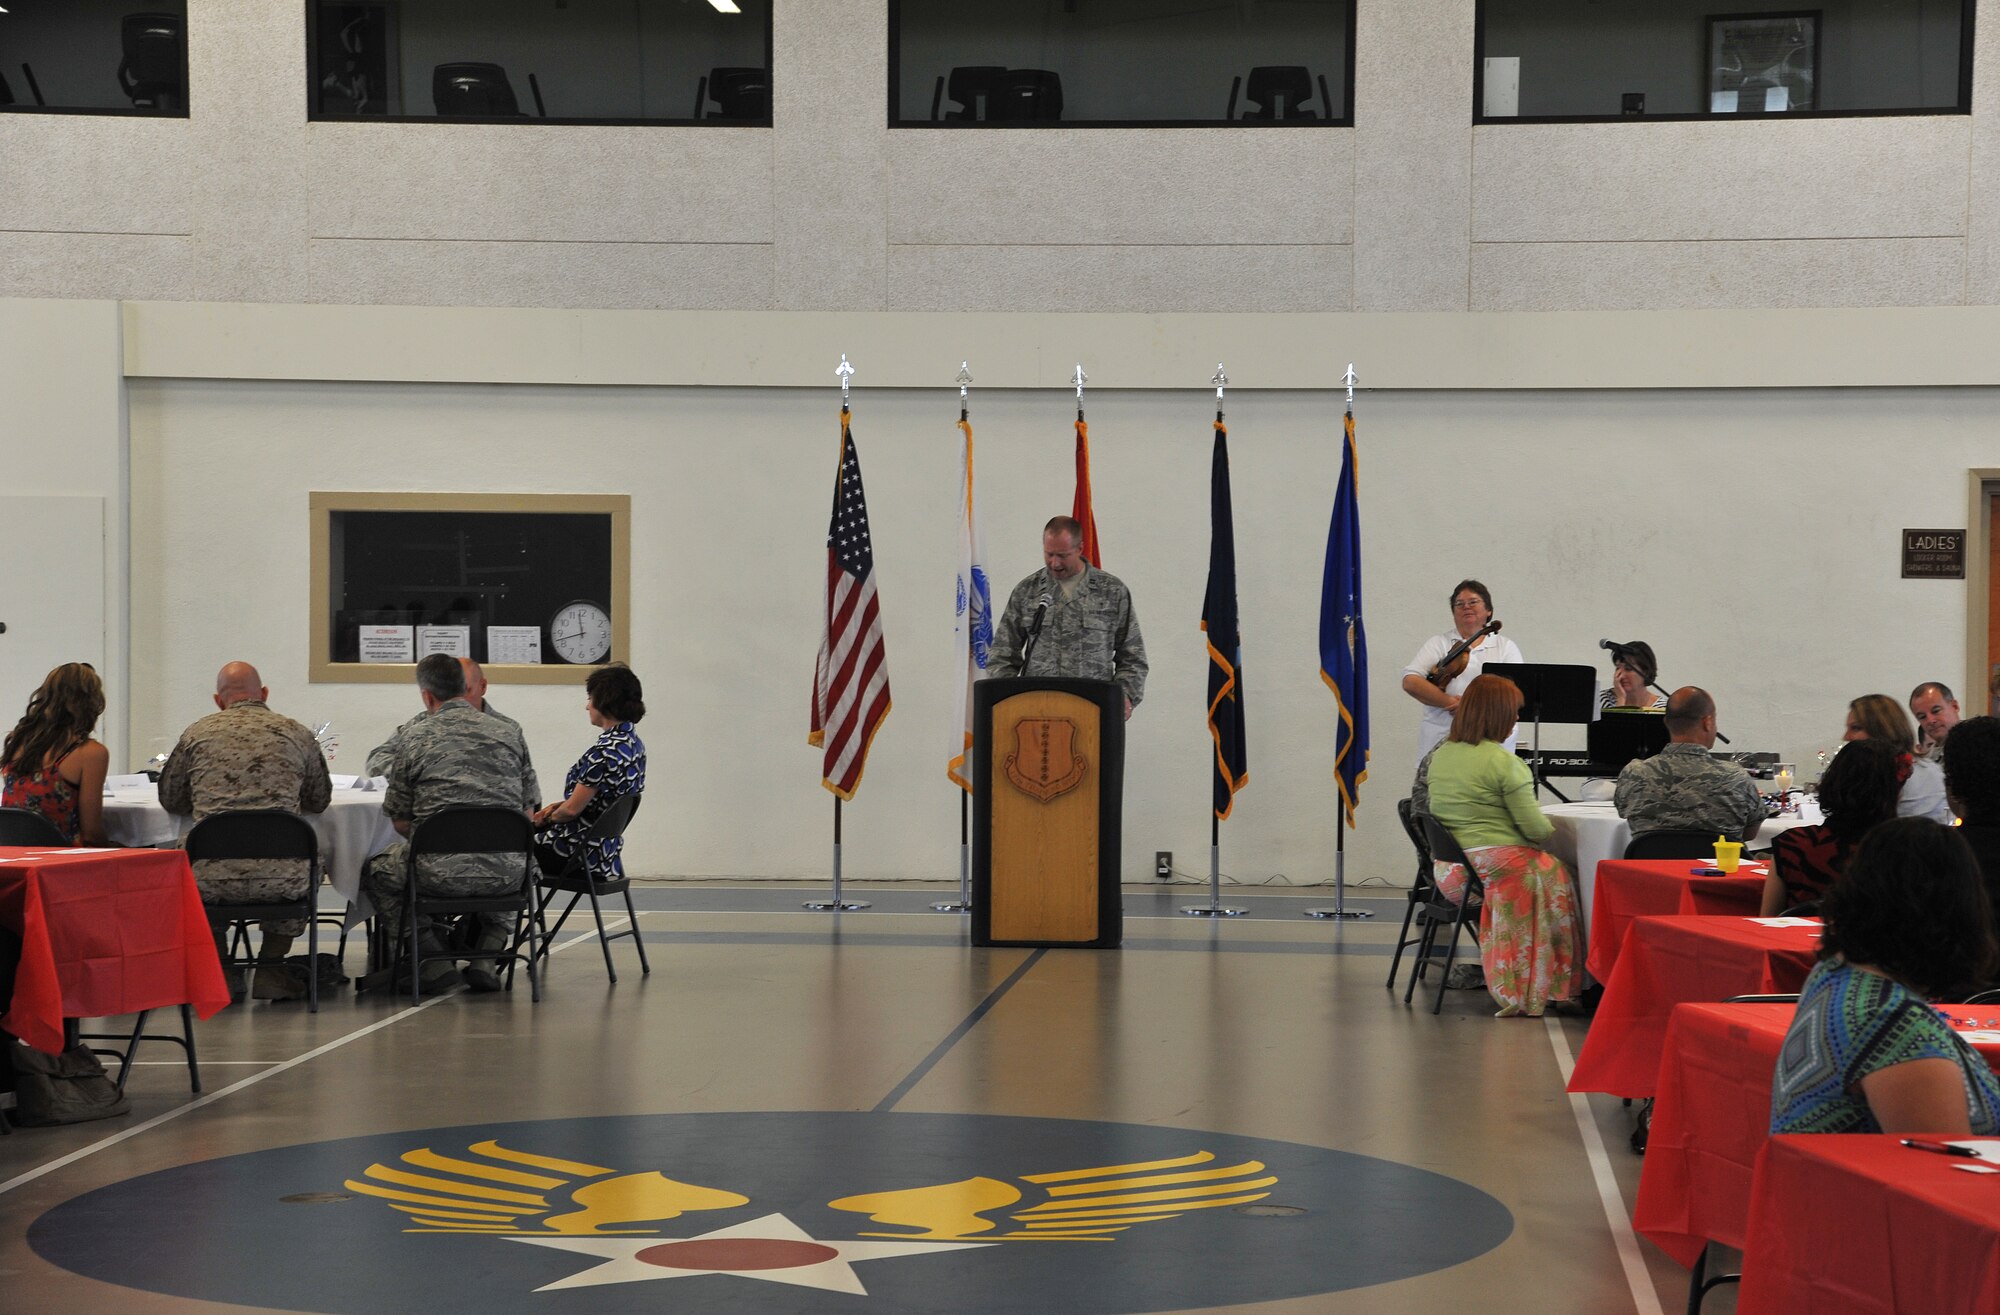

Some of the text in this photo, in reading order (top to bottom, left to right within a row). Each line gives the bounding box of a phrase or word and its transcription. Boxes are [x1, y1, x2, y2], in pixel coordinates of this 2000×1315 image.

[1908, 536, 1960, 550] LADIES'
[569, 611, 576, 620] 11
[578, 608, 587, 618] 12
[561, 619, 569, 627] 10
[597, 620, 604, 628] 2
[557, 630, 563, 638] 9
[601, 630, 606, 638] 3
[569, 648, 574, 656] 7
[590, 648, 596, 656] 5
